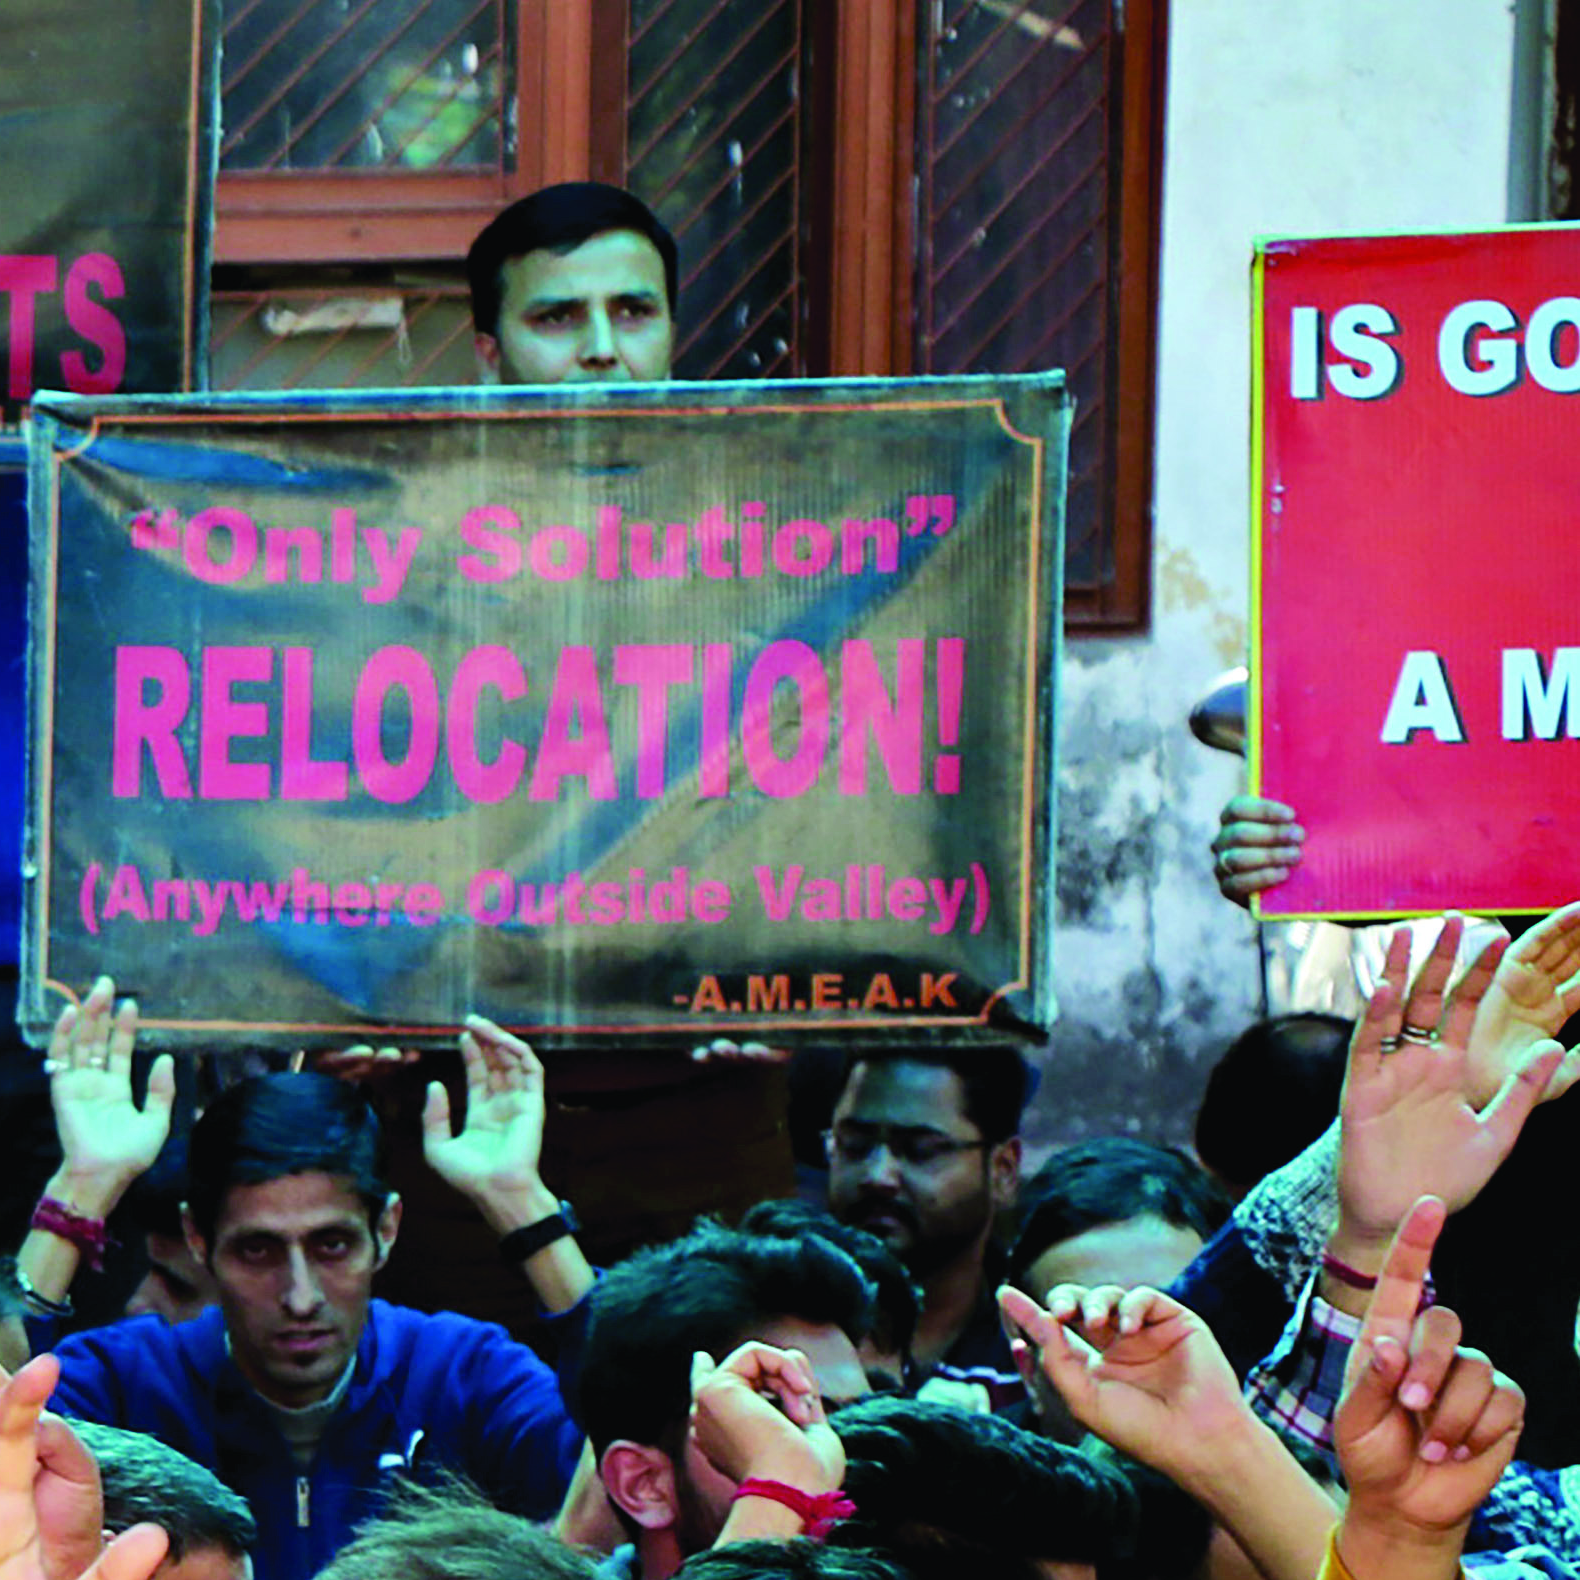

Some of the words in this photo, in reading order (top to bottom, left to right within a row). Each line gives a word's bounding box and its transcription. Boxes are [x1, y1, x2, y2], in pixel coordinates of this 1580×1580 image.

[1289, 303, 1402, 400] IS
[111, 637, 964, 804] RELOCATION!
[1380, 650, 1467, 745] A
[78, 862, 446, 938] (Anywhere
[465, 866, 733, 927] Outside
[753, 862, 990, 936] Valley)
[672, 972, 959, 1013] -A.M.E.A.K
